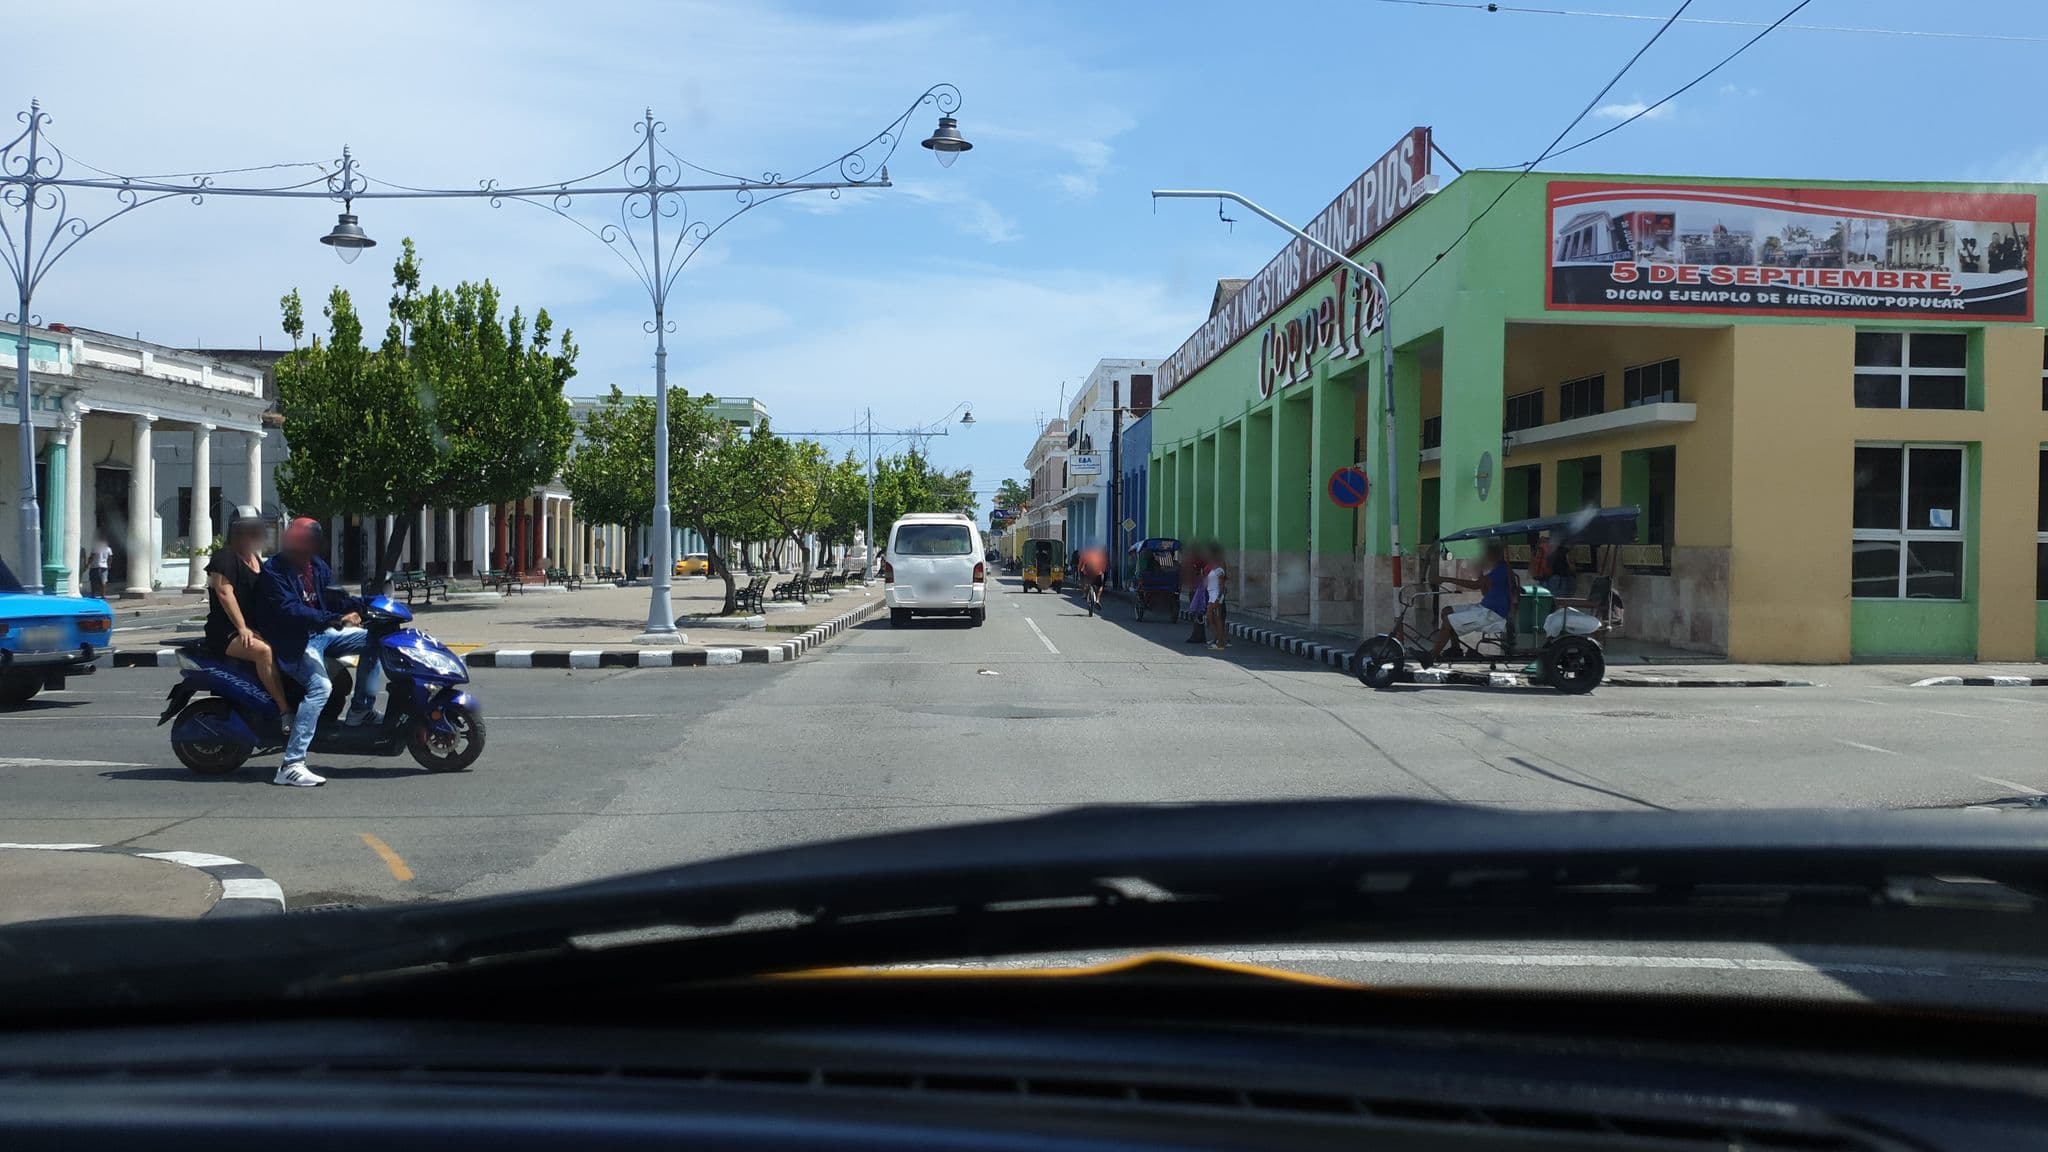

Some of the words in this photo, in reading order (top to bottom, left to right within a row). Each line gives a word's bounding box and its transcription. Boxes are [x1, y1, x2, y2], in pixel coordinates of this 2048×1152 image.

[1233, 294, 1240, 339] A
[1241, 238, 1301, 334] NUESTROS
[1305, 136, 1415, 280] PRINCIPIOS
[1611, 261, 1639, 283] 5
[1649, 265, 1701, 285] DE
[1708, 266, 1963, 296] SEPTIEMBRE,
[1258, 260, 1386, 401] Coppelia
[1605, 288, 1663, 301] DIGNO
[1669, 290, 1751, 304] EJEMPLO
[1757, 292, 1780, 304] DE
[1884, 295, 1965, 310] POPULAR
